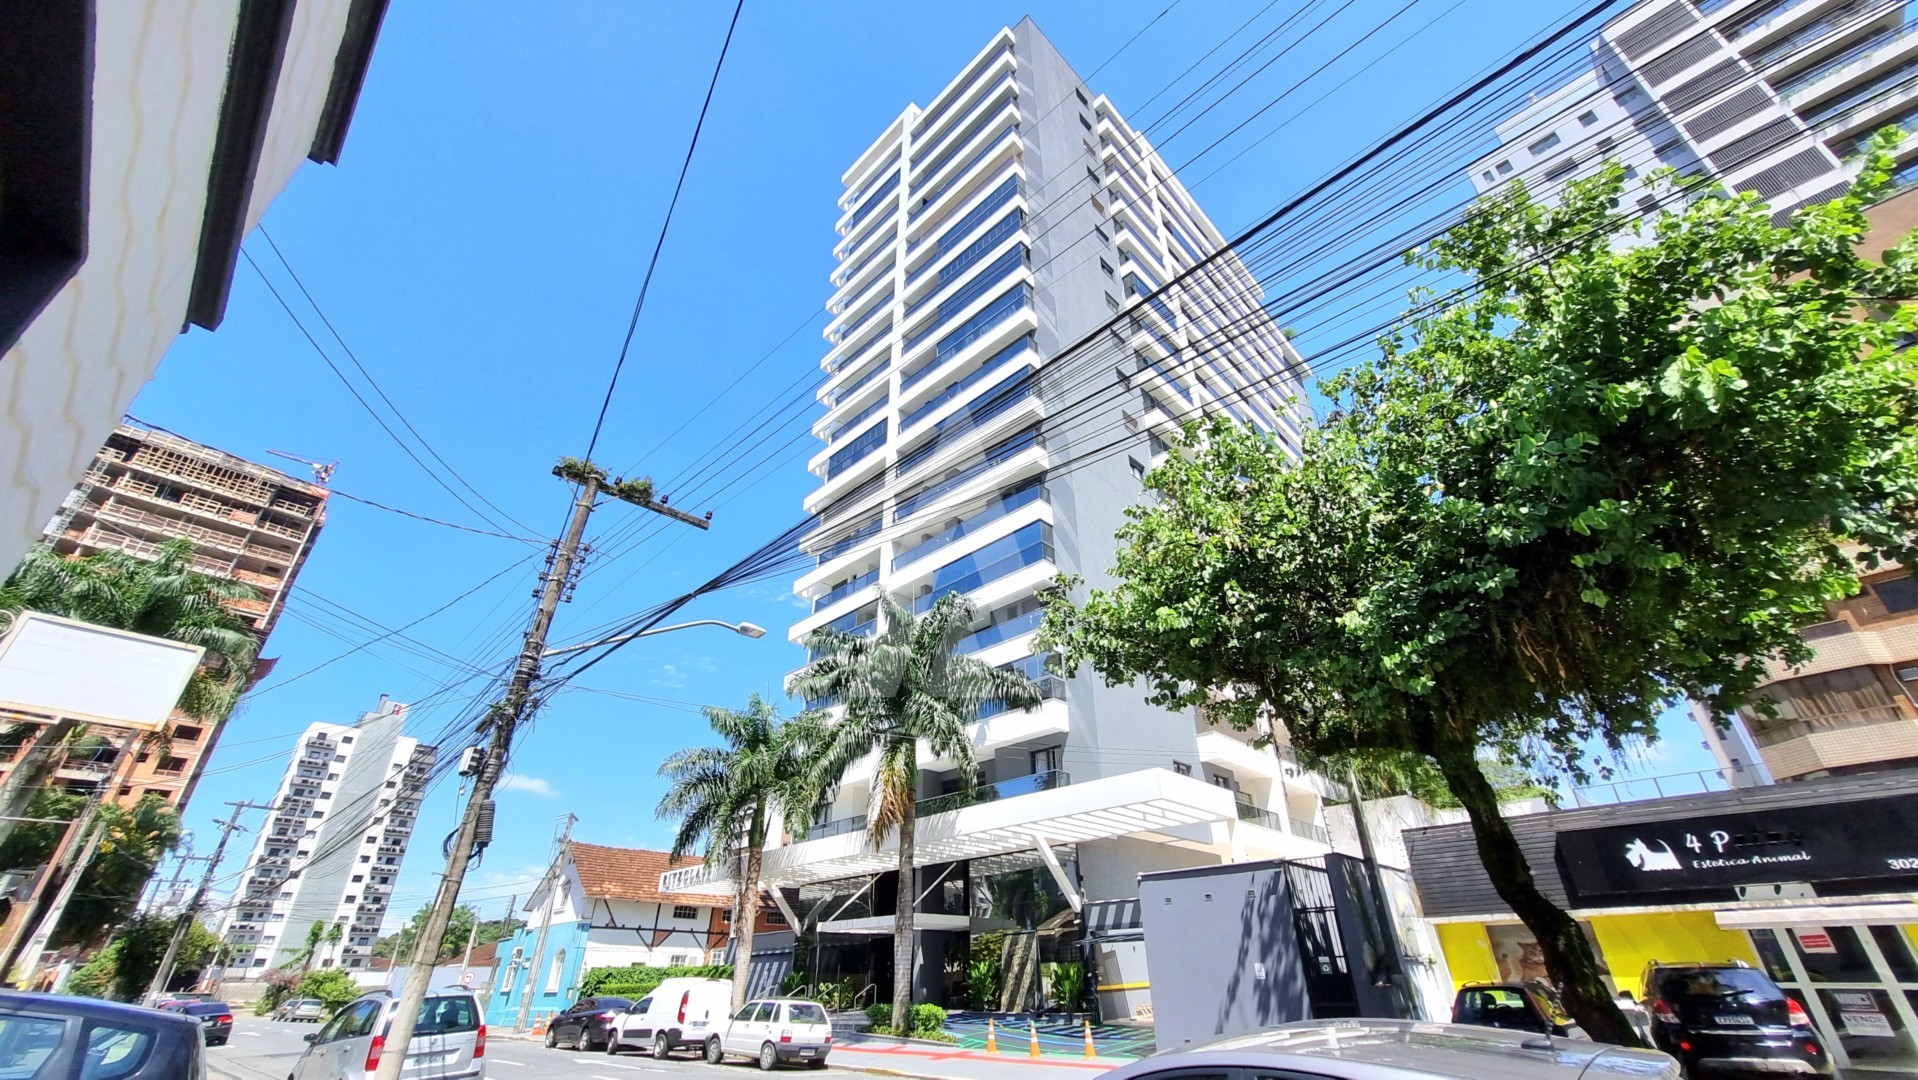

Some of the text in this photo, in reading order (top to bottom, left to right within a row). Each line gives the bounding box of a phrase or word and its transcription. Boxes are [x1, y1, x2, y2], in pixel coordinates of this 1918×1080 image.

[1686, 833, 1702, 853] 4
[1692, 851, 1811, 869] Estetica Animal
[1843, 1015, 1884, 1024] VENDE
